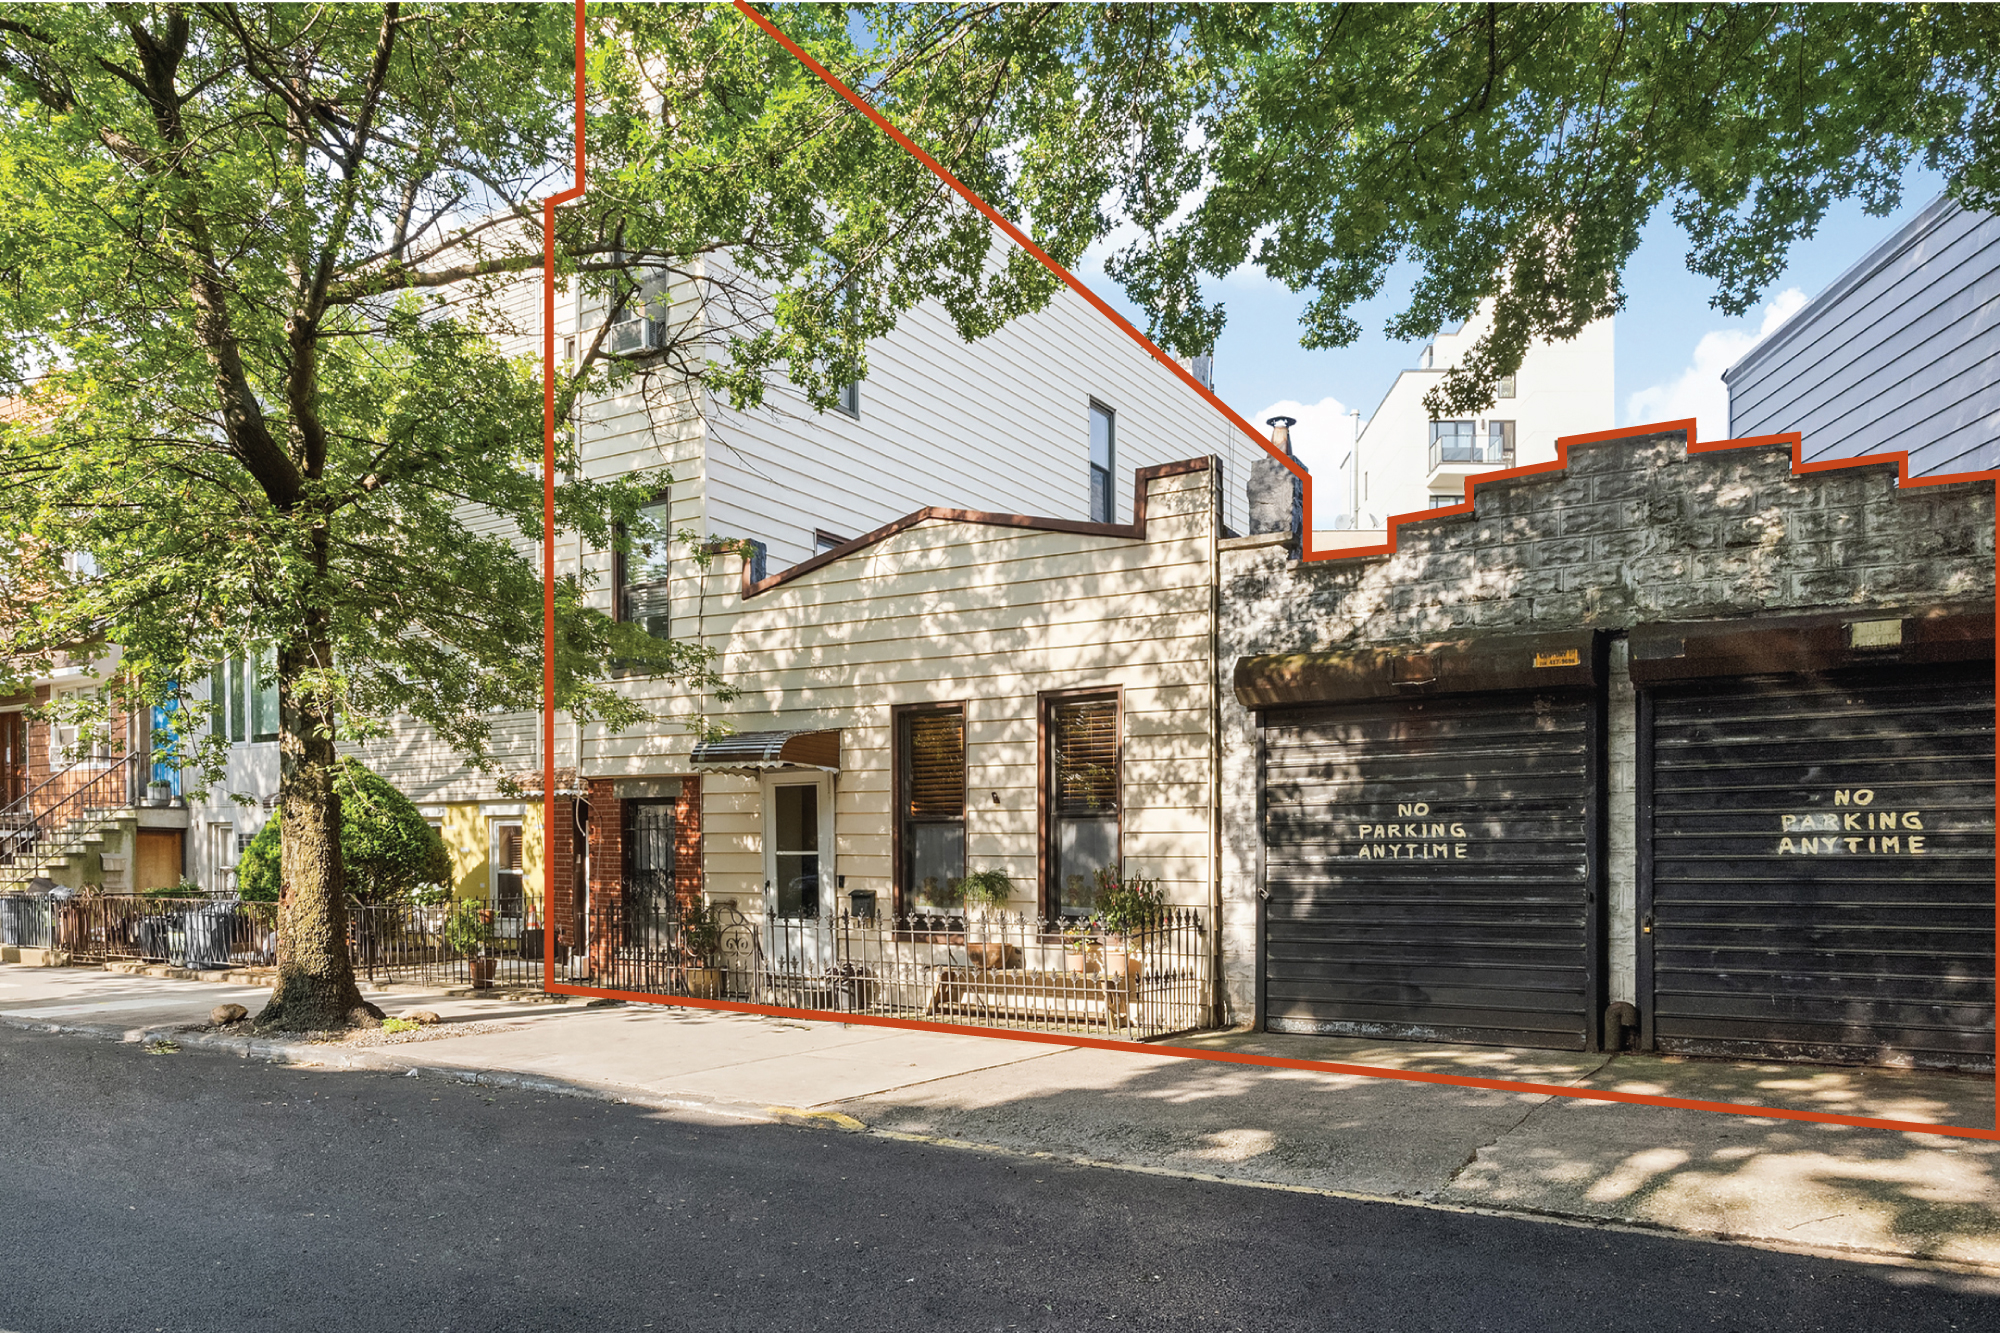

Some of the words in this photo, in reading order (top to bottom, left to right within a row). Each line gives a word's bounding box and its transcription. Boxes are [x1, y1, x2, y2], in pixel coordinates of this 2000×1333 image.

[1834, 789, 1875, 806] NO
[1398, 802, 1430, 818] NO
[1781, 811, 1924, 832] PARKING
[1358, 822, 1467, 839] PARKING
[1358, 843, 1468, 860] ANYTIME
[1778, 835, 1927, 855] ANYTIME
